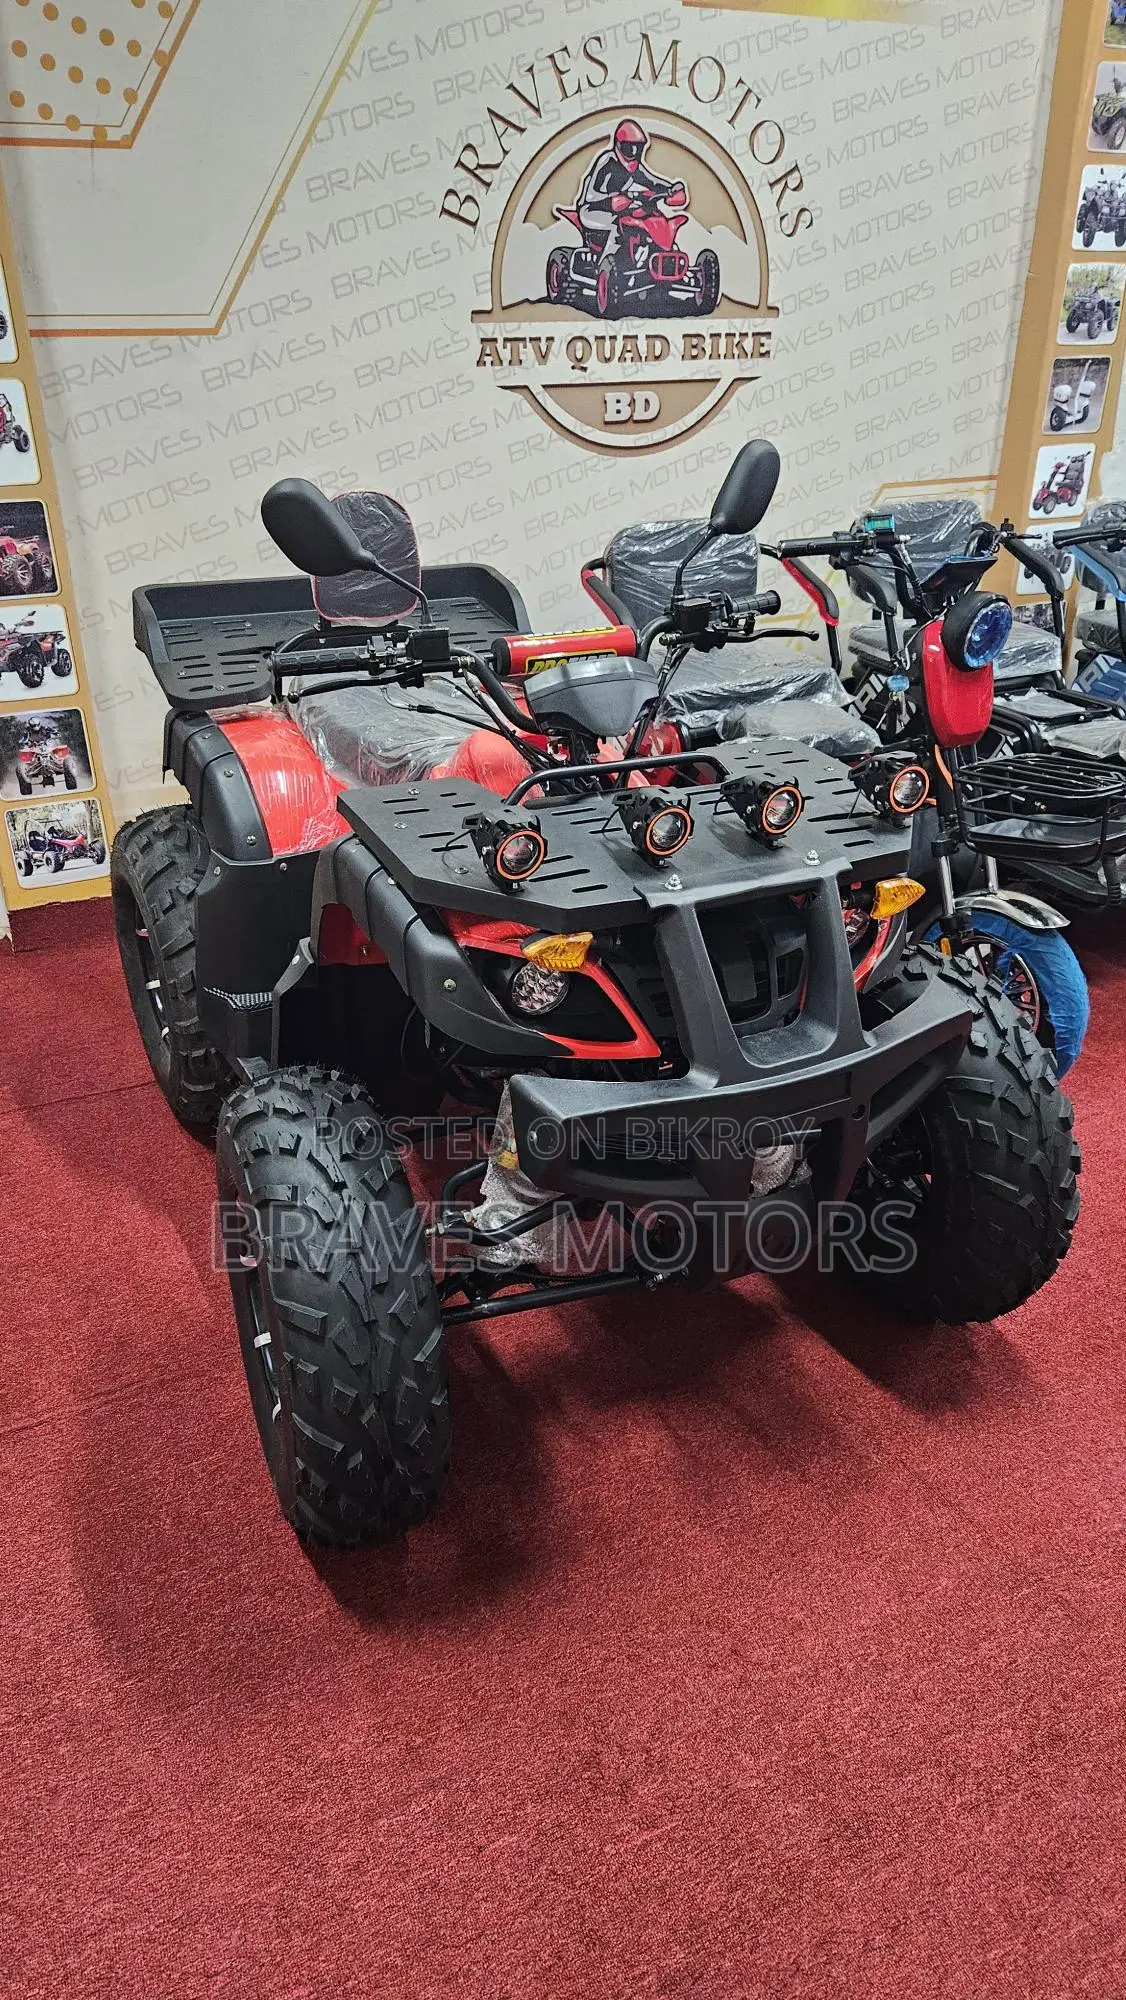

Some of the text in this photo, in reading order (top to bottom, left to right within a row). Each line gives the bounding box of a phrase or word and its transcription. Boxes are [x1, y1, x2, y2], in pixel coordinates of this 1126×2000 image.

[414, 0, 545, 60] MOTORS
[820, 26, 925, 79] MOTORS
[311, 91, 415, 145] OTORS
[826, 114, 928, 168] MOTORS
[944, 76, 1036, 127] BRAVES
[832, 72, 930, 123] BRAVES
[936, 36, 1035, 88] MOTORS
[305, 143, 431, 202] BRAVES
[438, 32, 813, 239] BRAVES MOTORS
[839, 159, 933, 210] BRAVES
[939, 121, 1035, 173] MOTORS
[305, 191, 436, 253] MOTORS
[768, 160, 1037, 277] AVES MOTORS BRAVES
[844, 240, 937, 292] BRAVES
[38, 337, 173, 400] BRAVES
[330, 240, 451, 299] BRAVES
[200, 332, 327, 393] BRAVES
[330, 285, 456, 347] MOTORS
[476, 336, 555, 367] ATV
[565, 334, 671, 373] QUAD
[681, 331, 773, 361] BIKE
[737, 284, 1022, 416] MOTORS BRAVES MOTOR
[773, 319, 833, 360] AVES
[838, 279, 935, 332] MOTORS
[72, 331, 470, 491] BRAVES MOTORS BRAVES
[375, 415, 488, 473] BRAVES
[523, 485, 625, 541] BRAVES
[629, 440, 732, 498] MOTORS
[844, 354, 937, 408] MOTORS
[951, 320, 1019, 364] BRAVE
[604, 391, 661, 424] BD
[781, 435, 840, 471] TORS
[854, 392, 941, 443] BRAVES
[947, 360, 1012, 403] MOTO
[75, 471, 212, 537] MOTORS
[228, 420, 349, 480] BRAVES
[353, 374, 475, 434] MOTORS
[394, 455, 492, 505] OTORS
[507, 427, 567, 465] BRA
[771, 468, 843, 511] RAVES
[849, 427, 940, 480] MOTORS
[954, 401, 1006, 434] BRAV
[415, 455, 618, 545] RAVES MOTORS
[767, 505, 845, 545] OTORS
[104, 513, 230, 575] BRAVES
